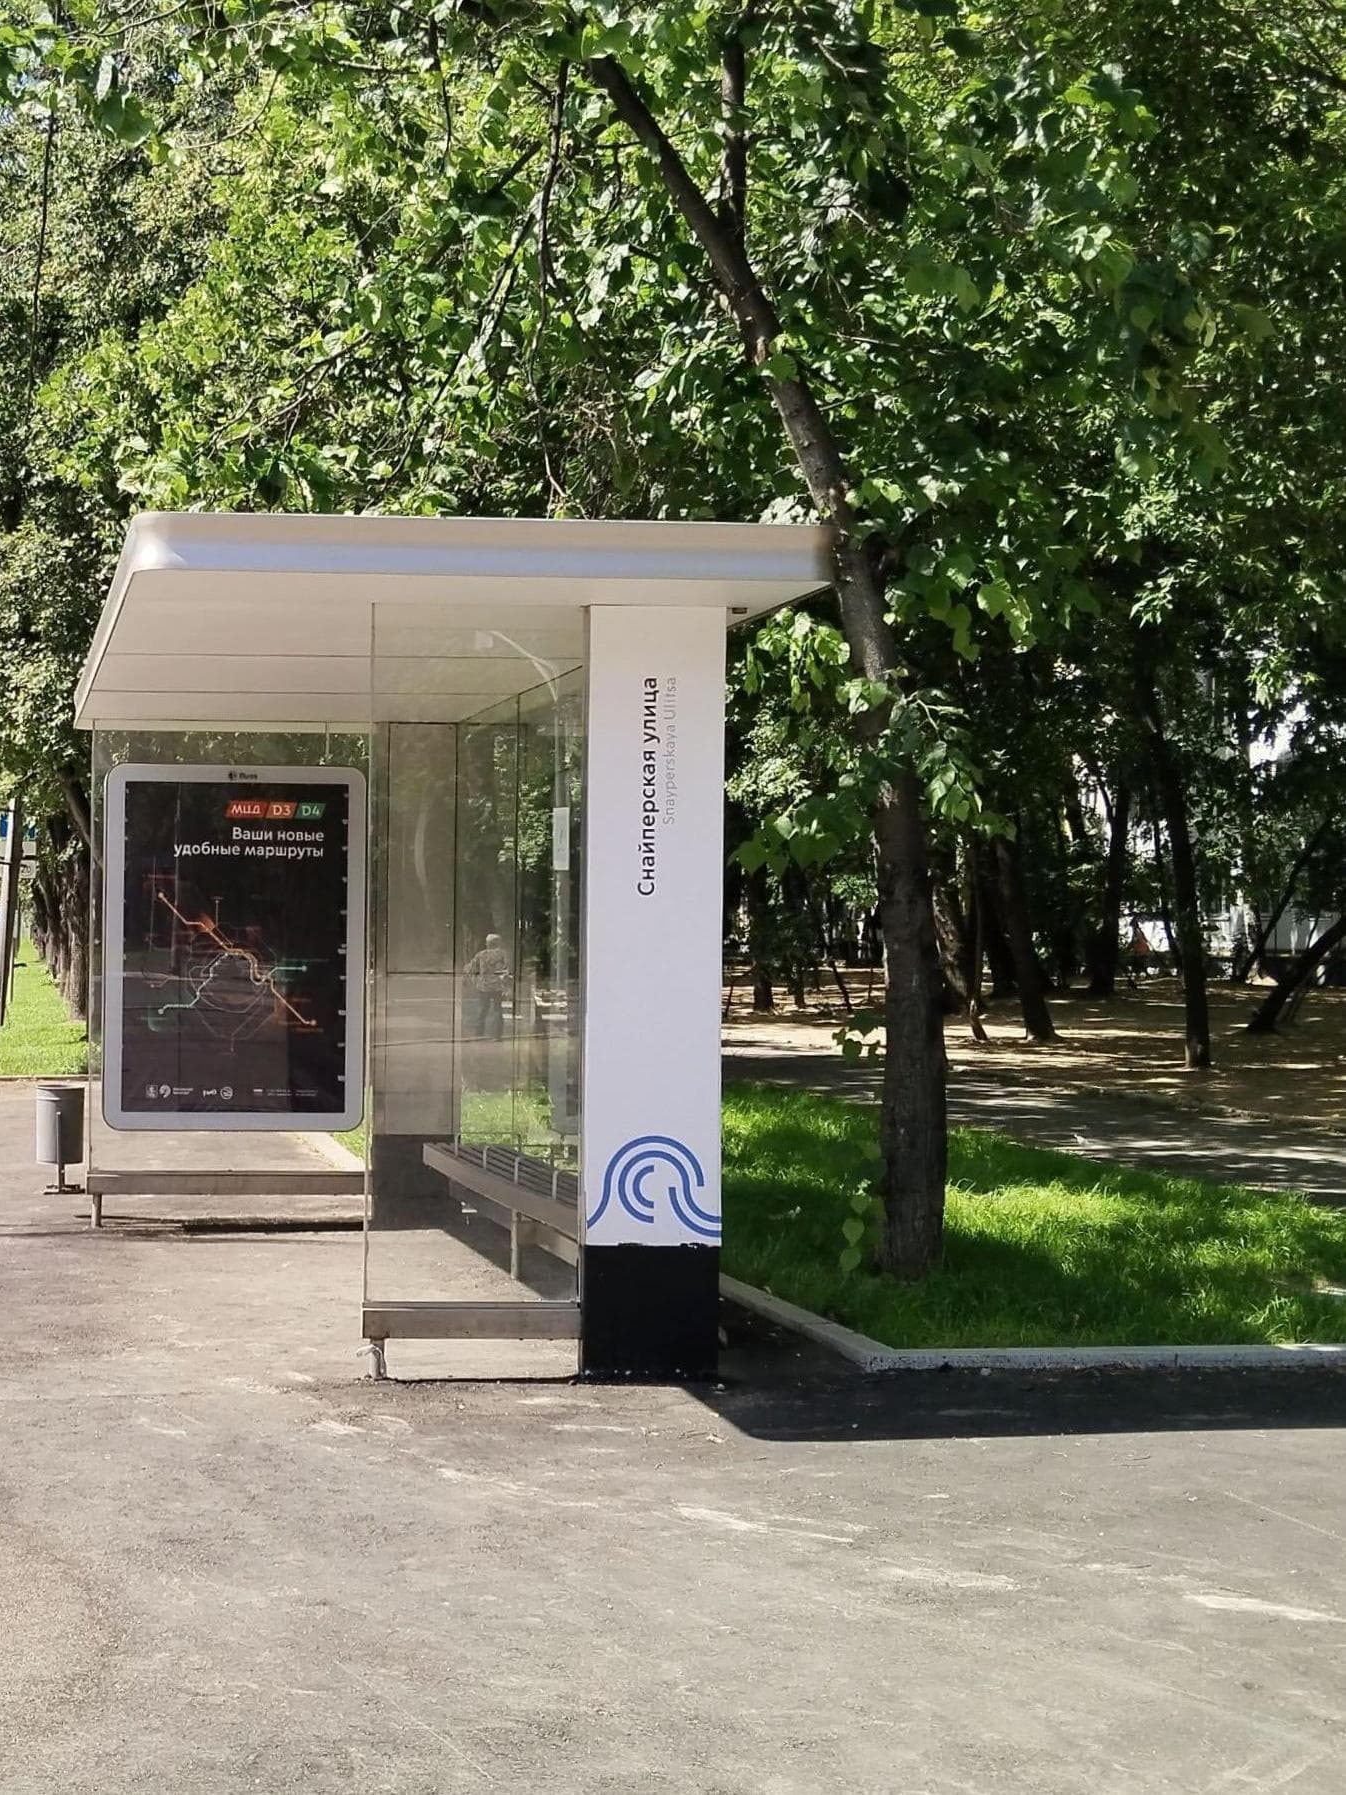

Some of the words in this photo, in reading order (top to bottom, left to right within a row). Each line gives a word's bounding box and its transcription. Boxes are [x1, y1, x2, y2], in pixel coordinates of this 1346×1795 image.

[643, 677, 660, 743] улица
[663, 676, 677, 720] Ulitsa
[662, 724, 678, 825] Snayperskaya
[272, 804, 292, 816] D3
[301, 805, 320, 816] D4
[637, 750, 659, 896] Снайперская
[173, 842, 241, 857] удобные
[244, 846, 324, 860] маршруты
[232, 826, 273, 841] Ваши
[277, 830, 325, 842] новые
